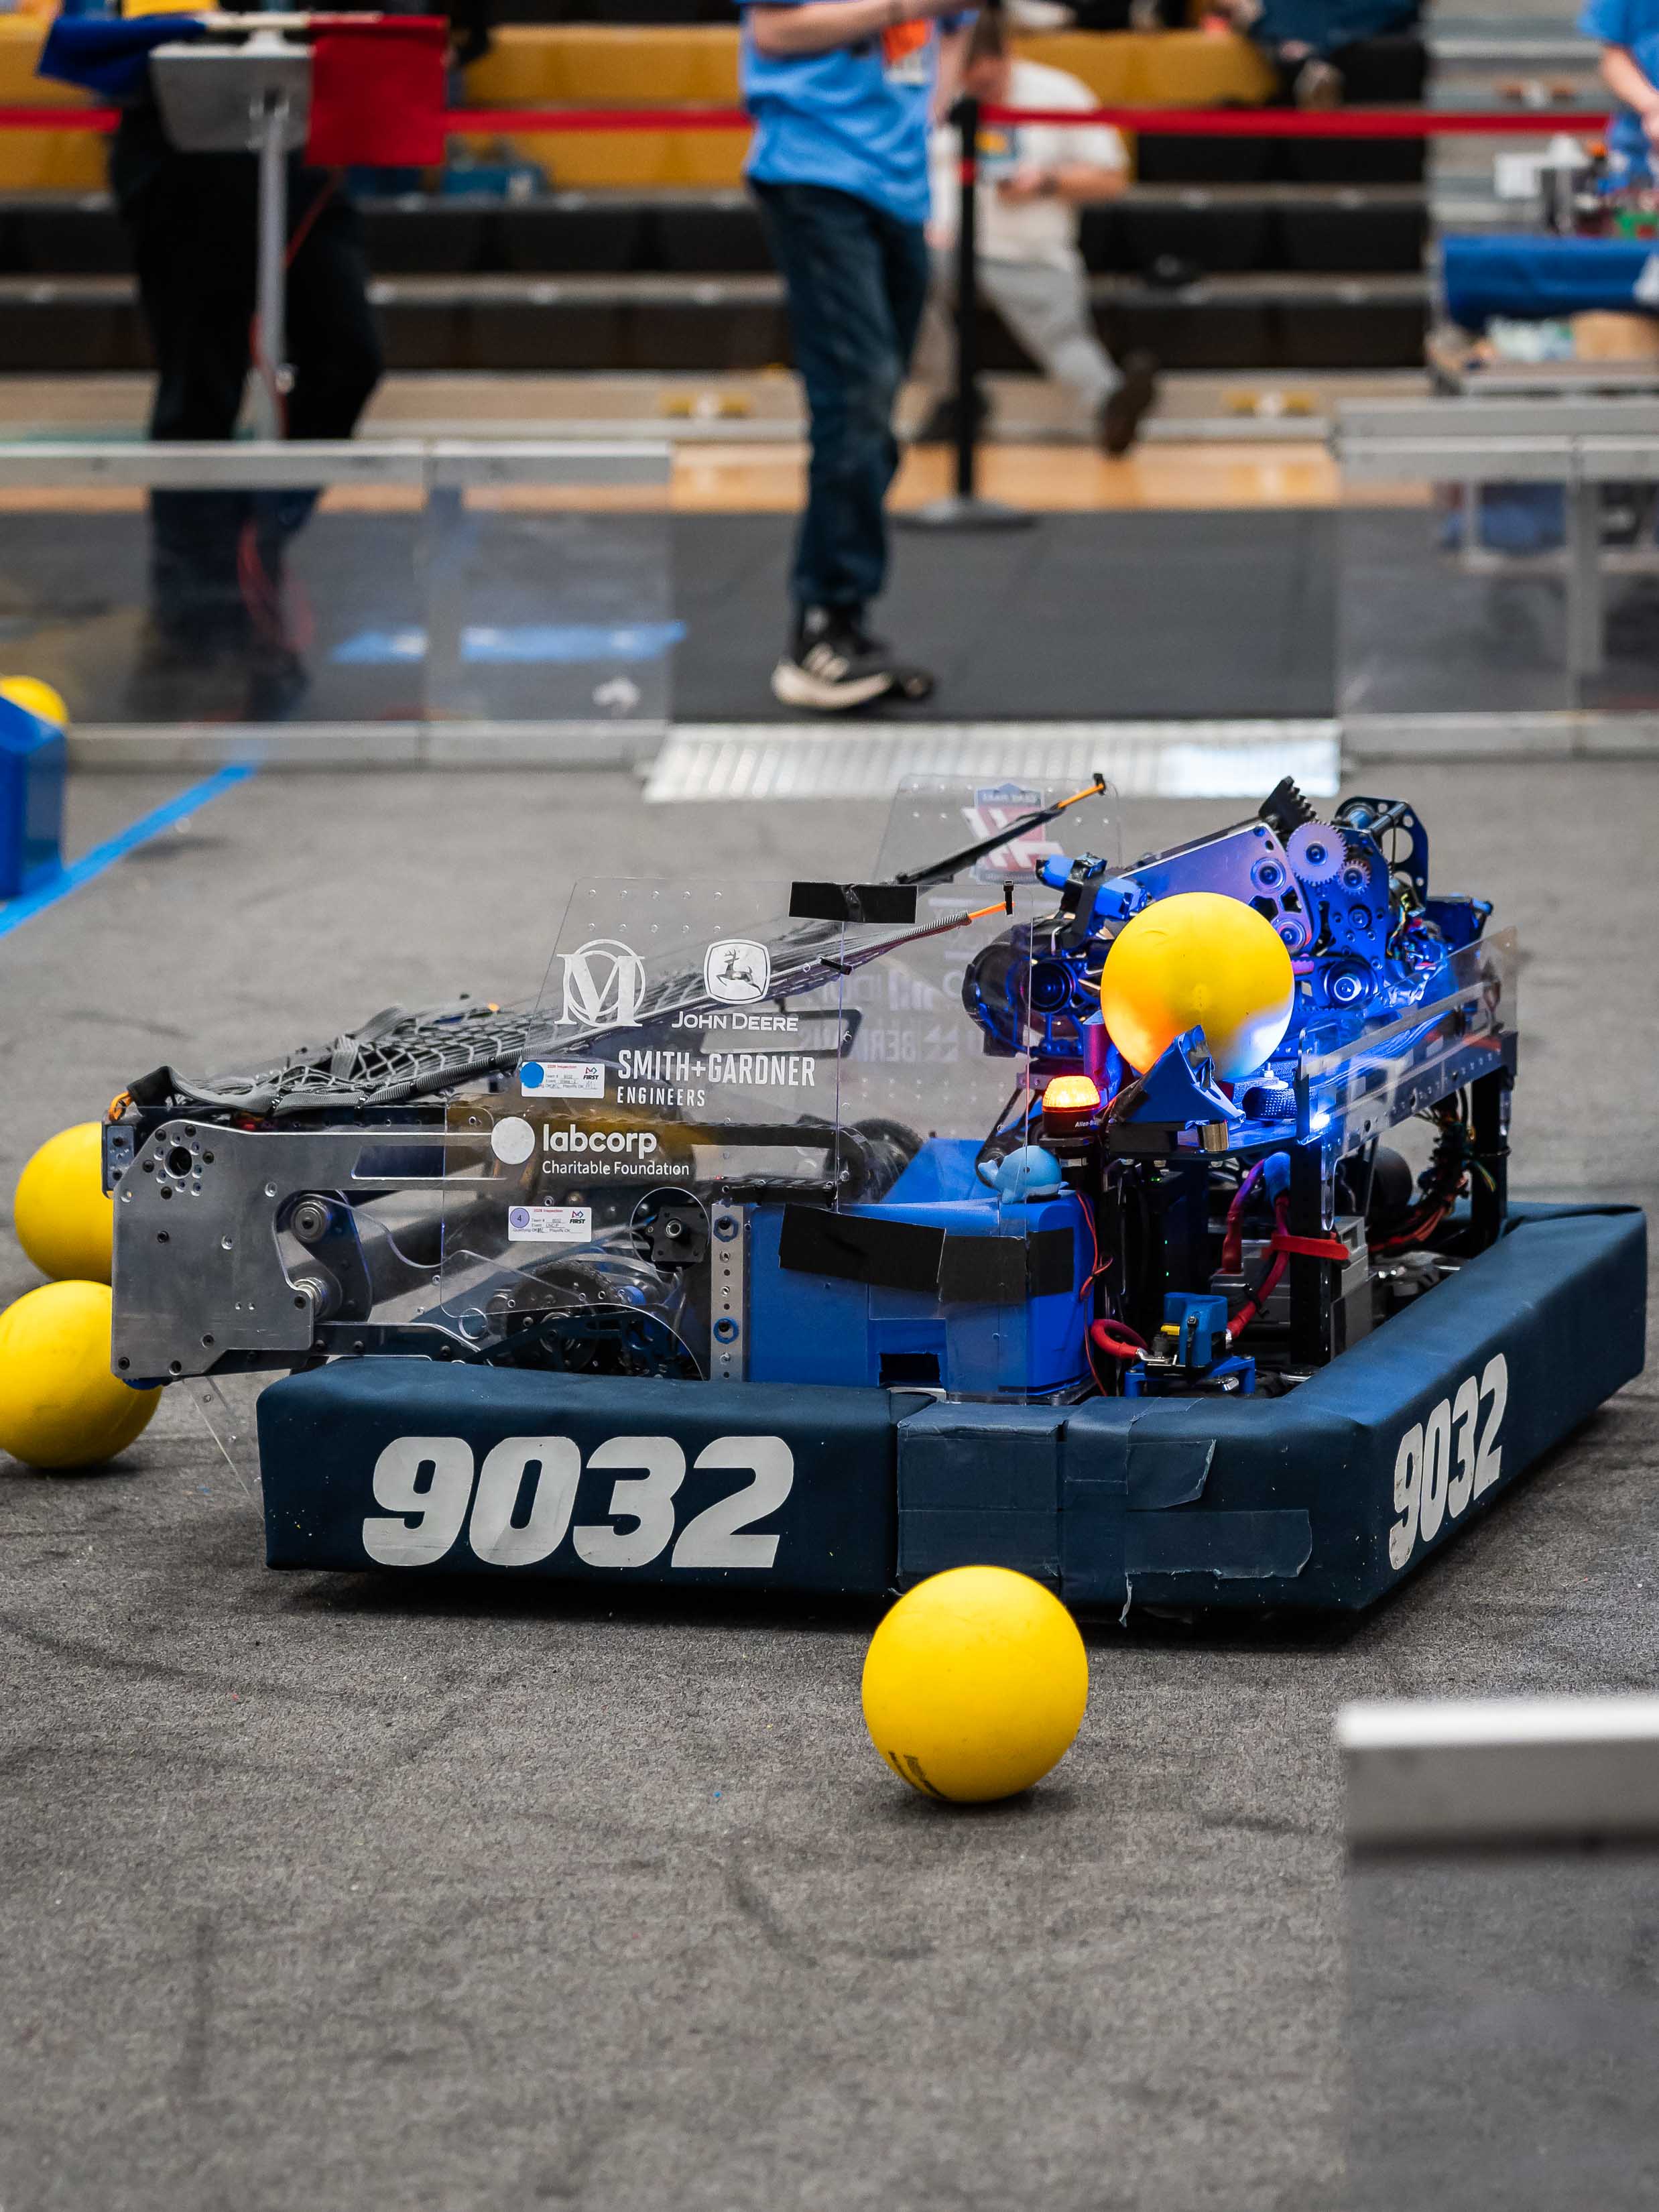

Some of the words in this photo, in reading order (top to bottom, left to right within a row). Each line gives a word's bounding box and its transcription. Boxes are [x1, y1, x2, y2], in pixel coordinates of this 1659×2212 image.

[671, 1011, 727, 1030] JOHN
[732, 1013, 799, 1032] DEERE
[617, 1050, 815, 1087] SMITH+GARDNER
[617, 1086, 705, 1107] ENGINEERS
[543, 1123, 657, 1159] labcorp
[542, 1160, 611, 1174] Charitable
[614, 1161, 689, 1175] Foundation
[1389, 1353, 1508, 1571] 9032
[362, 1436, 794, 1568] 9032
